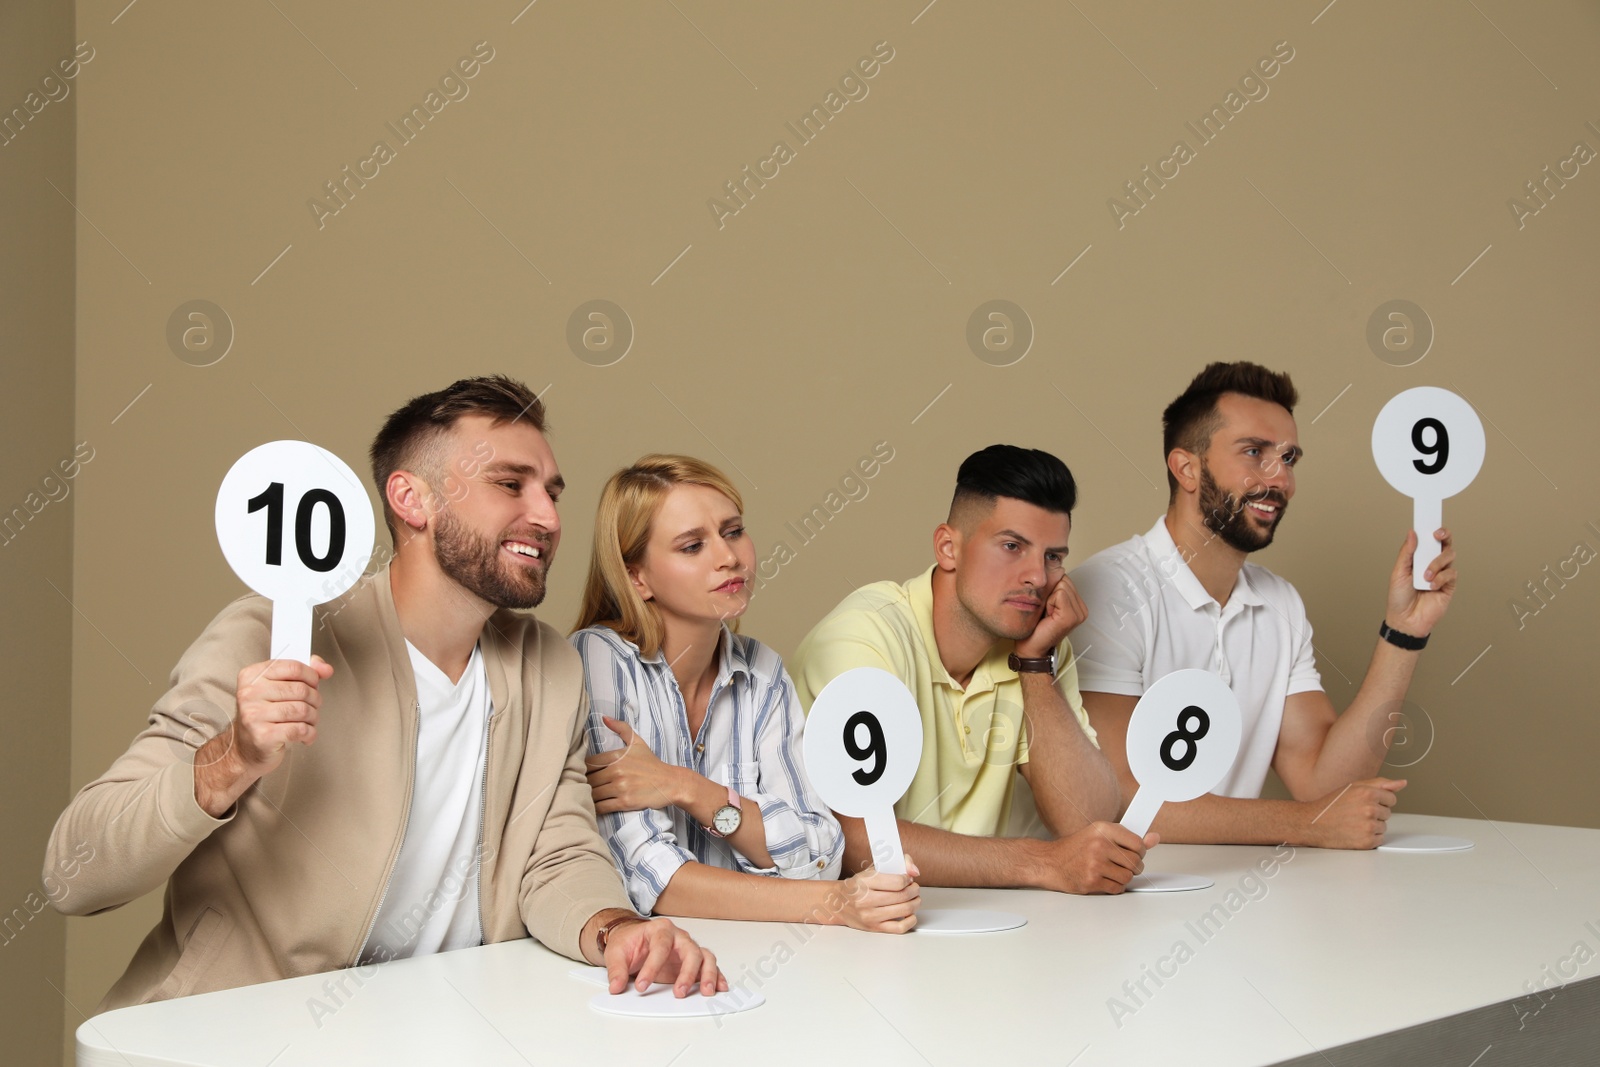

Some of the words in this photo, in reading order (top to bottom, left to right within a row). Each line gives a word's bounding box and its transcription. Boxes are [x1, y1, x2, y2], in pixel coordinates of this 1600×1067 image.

[1411, 417, 1450, 475] 9
[247, 481, 346, 573] 10
[842, 710, 888, 786] 9
[1159, 705, 1211, 772] 8
